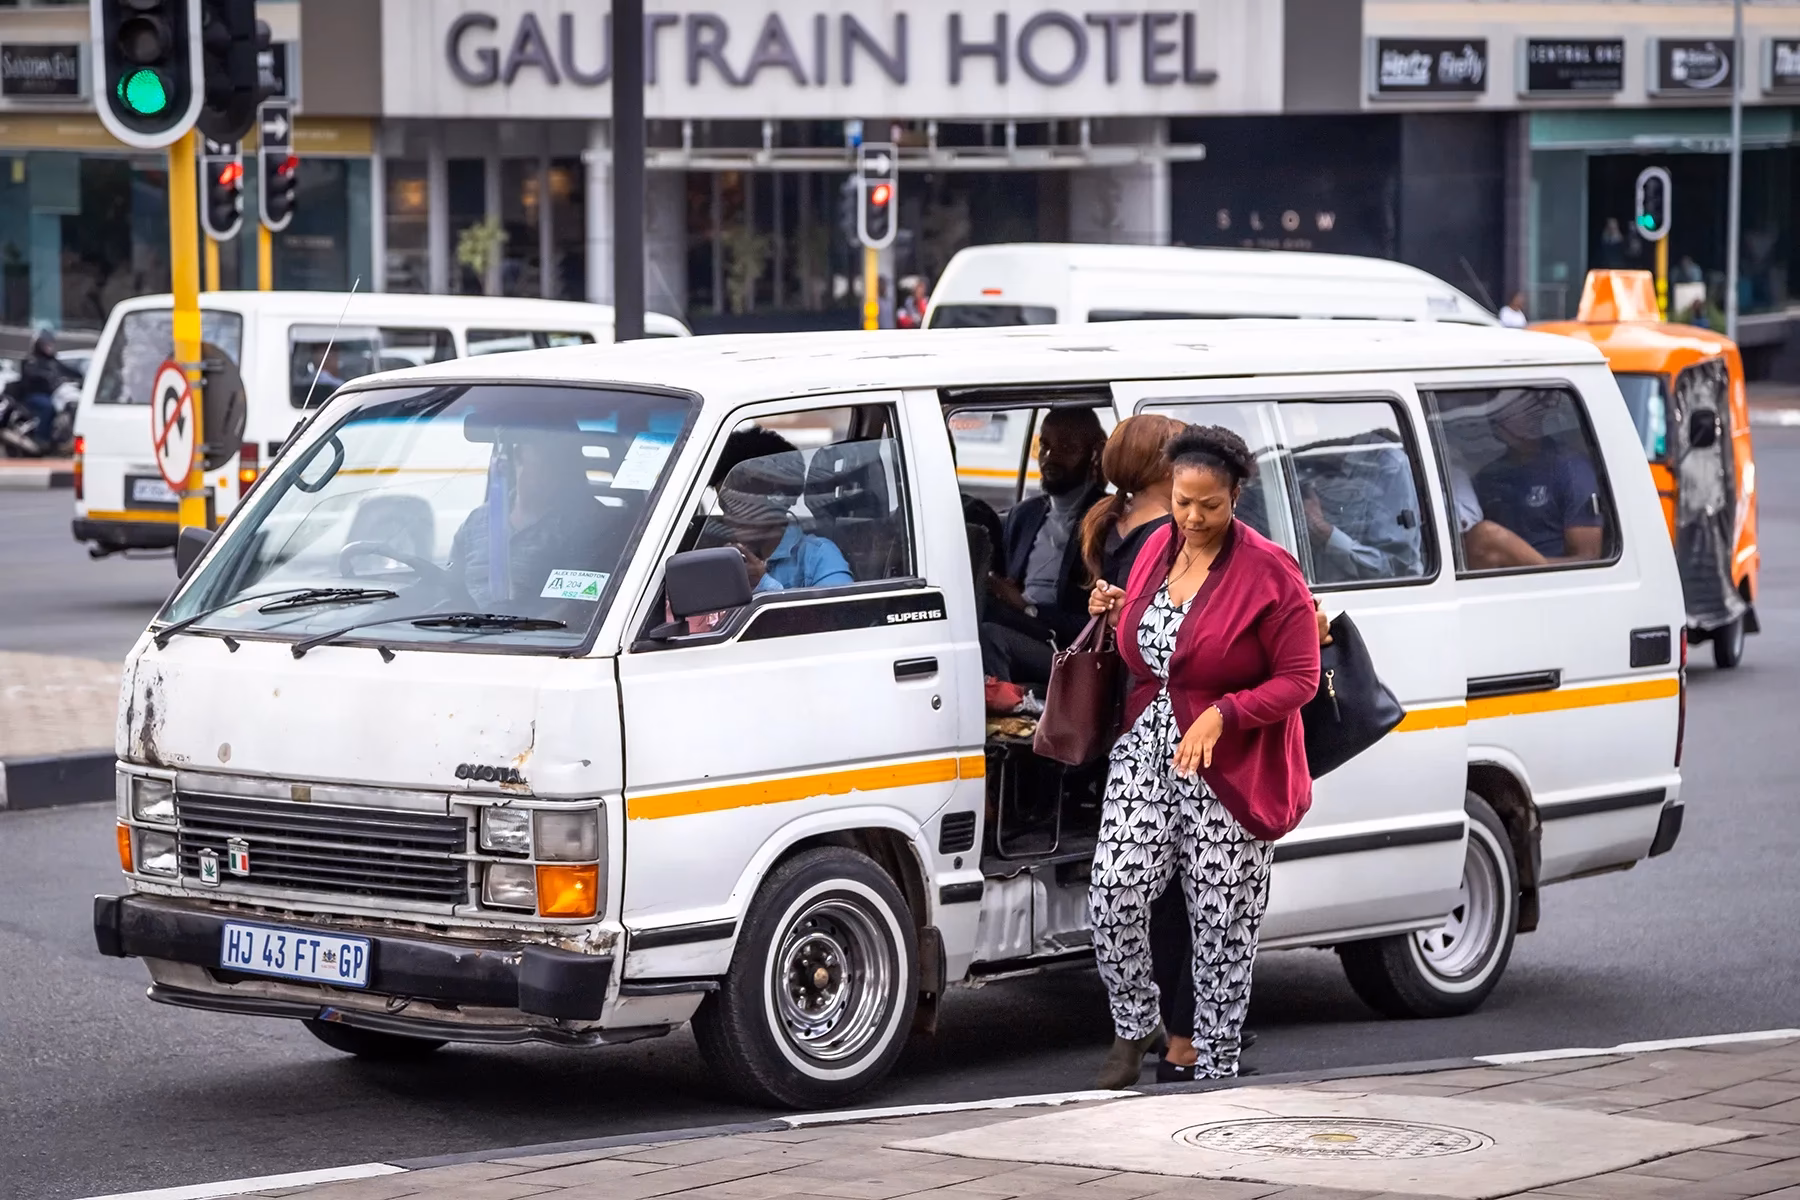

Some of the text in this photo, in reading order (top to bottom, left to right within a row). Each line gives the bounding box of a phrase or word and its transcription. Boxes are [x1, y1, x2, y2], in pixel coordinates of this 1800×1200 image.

[446, 10, 1218, 87] GAUTRAIN HOTEL
[561, 590, 579, 598] RS2
[566, 580, 583, 588] 204
[228, 929, 364, 979] HJ 43 FT GP
